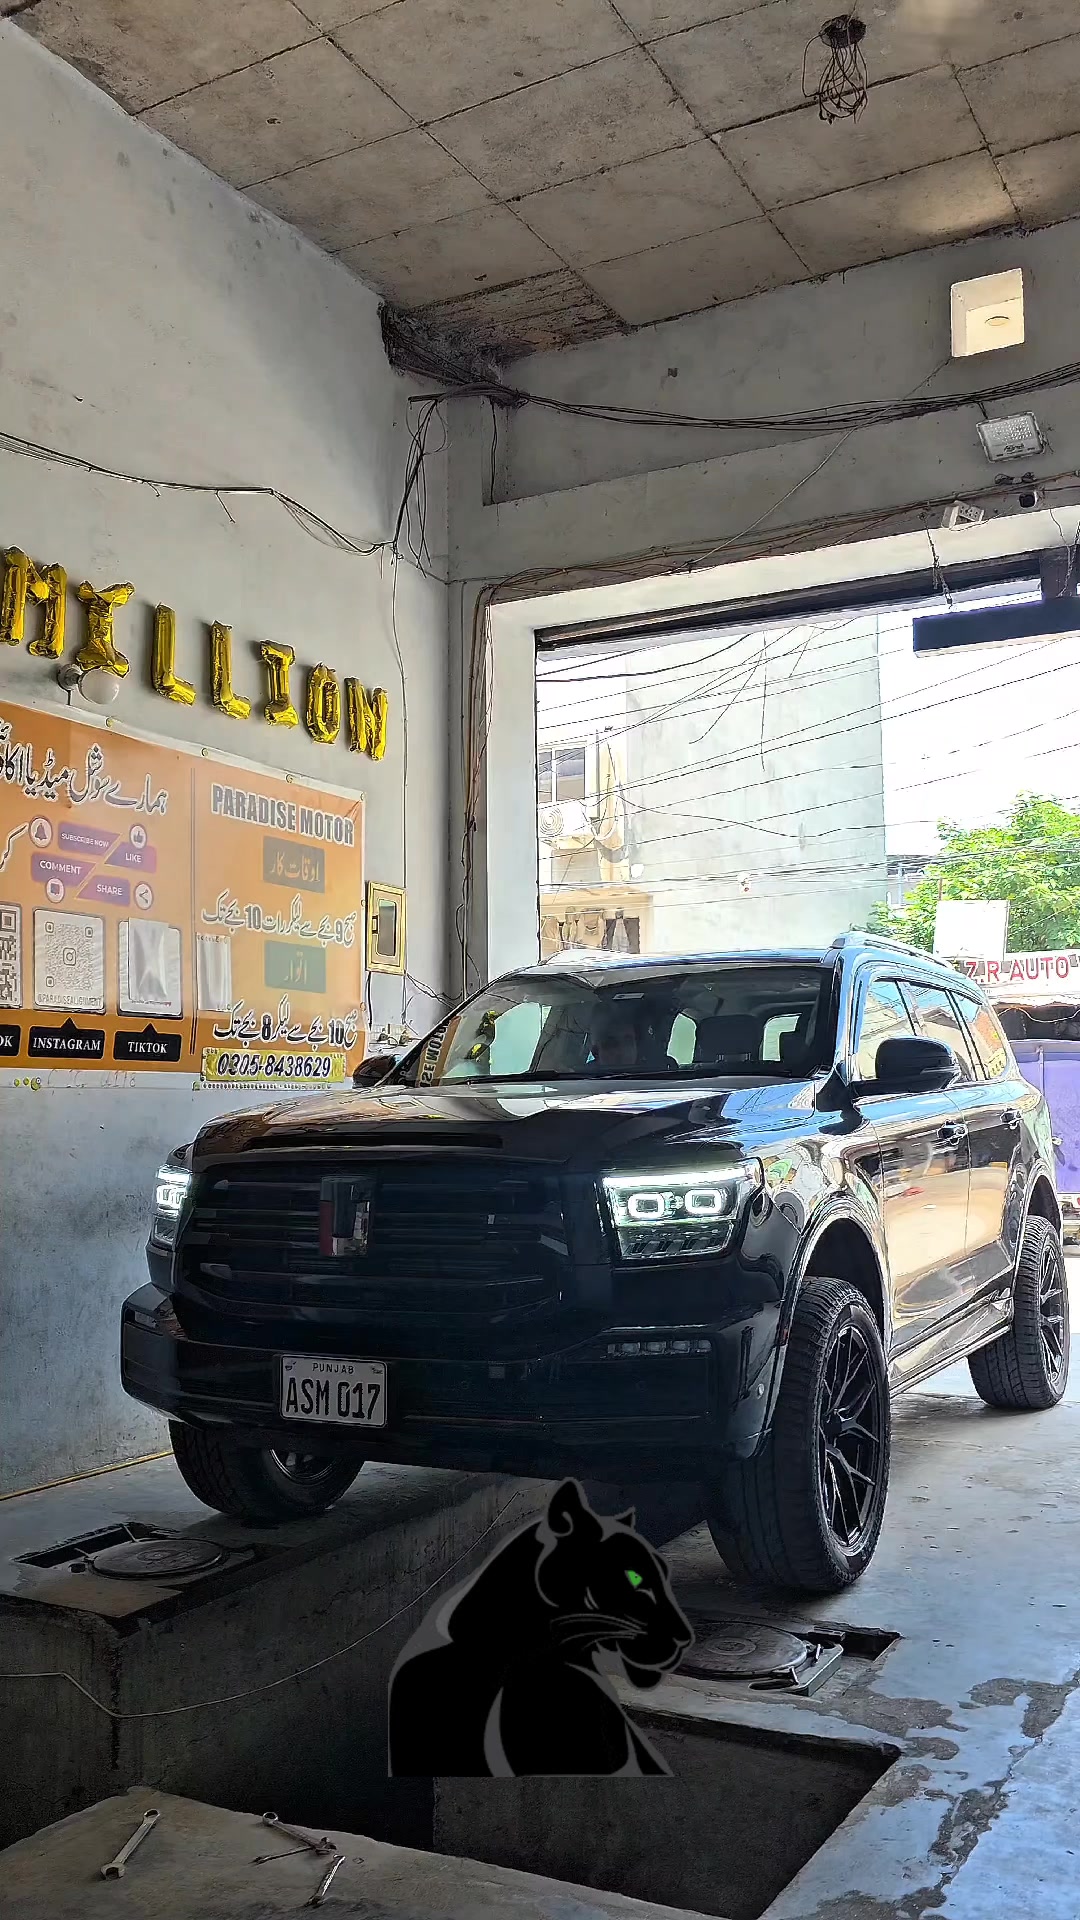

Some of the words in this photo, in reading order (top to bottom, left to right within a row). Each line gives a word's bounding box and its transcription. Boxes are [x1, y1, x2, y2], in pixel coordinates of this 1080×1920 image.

[0, 545, 388, 762] MILLION
[25, 743, 71, 800] میڈیا
[105, 773, 167, 814] ہمارے
[211, 784, 297, 832] PARADISE
[300, 807, 355, 846] MOTOR
[61, 832, 94, 846] SUBSCRIBE
[94, 839, 110, 849] NOW
[39, 860, 82, 876] COMMENT
[125, 853, 142, 864] LIKE
[271, 851, 284, 877] کار
[285, 855, 320, 882] اوقات
[96, 884, 123, 896] SHARE
[245, 905, 261, 930] 10
[334, 922, 344, 944] 9
[1010, 956, 1070, 980] AUTO
[261, 1014, 272, 1041] 8
[328, 1019, 344, 1045] 10
[33, 1037, 101, 1050] INSTAGRAM
[128, 1041, 168, 1054] TIKTOK
[217, 1053, 331, 1077] 0305-8438629
[312, 1362, 354, 1375] PUNJAB
[285, 1376, 330, 1416] ASM
[337, 1380, 381, 1420] 017
